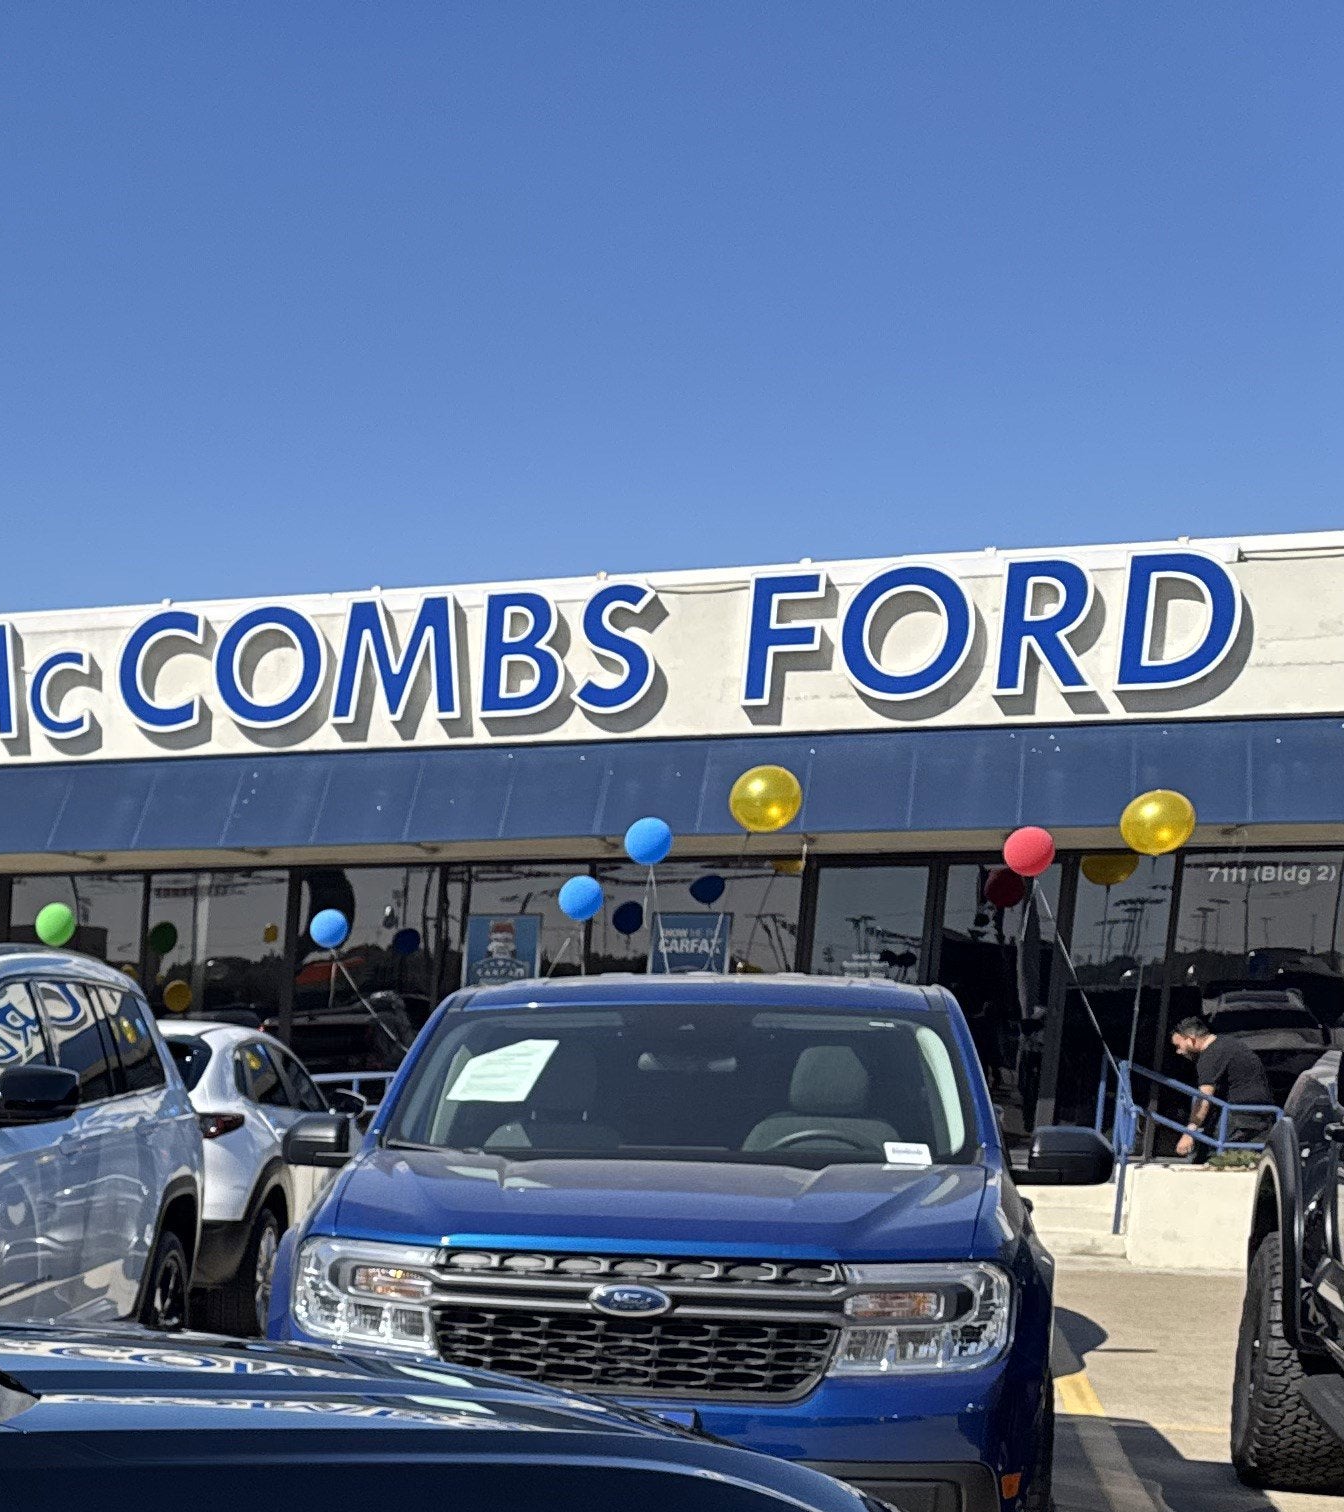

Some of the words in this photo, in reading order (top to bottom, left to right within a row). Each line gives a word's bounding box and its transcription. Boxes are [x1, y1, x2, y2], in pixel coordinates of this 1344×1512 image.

[741, 550, 1243, 707] FORD
[1207, 866, 1248, 883] 7111
[1253, 865, 1311, 885] (Bldg
[1316, 865, 1337, 882] 2)
